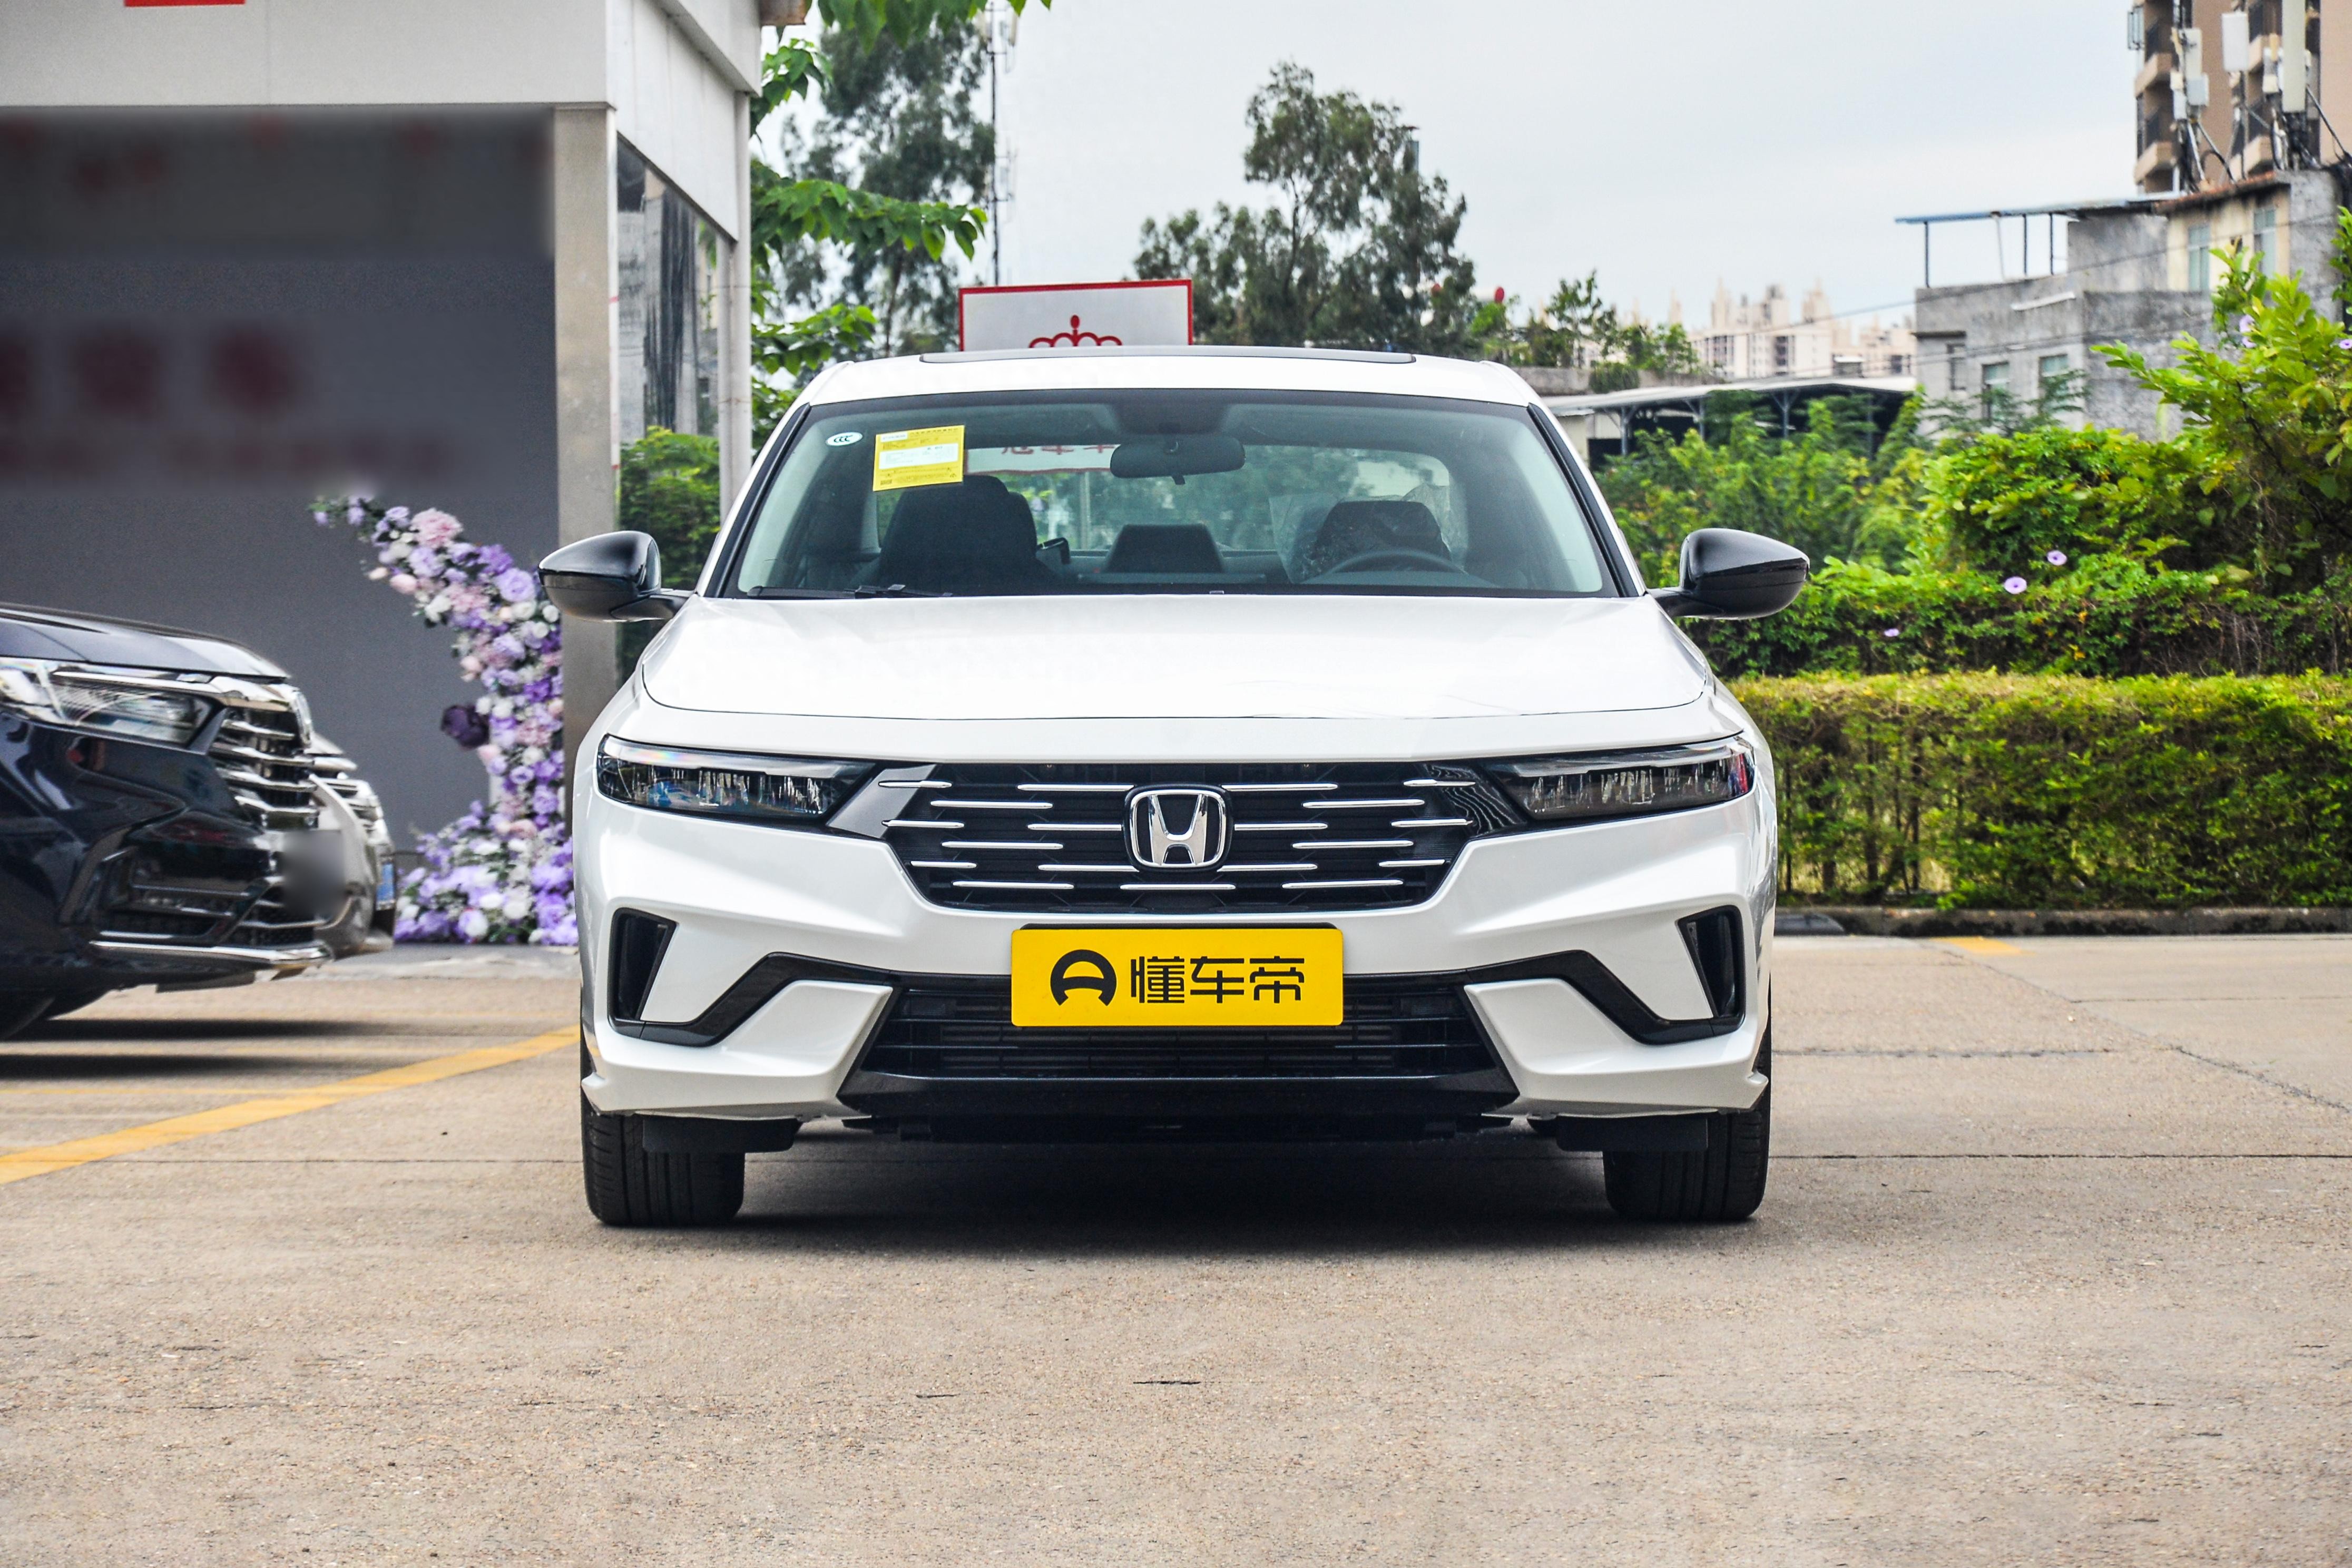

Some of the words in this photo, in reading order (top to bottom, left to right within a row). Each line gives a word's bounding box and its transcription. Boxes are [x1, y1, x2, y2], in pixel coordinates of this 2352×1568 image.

[1148, 793, 1208, 866] H
[1131, 956, 1305, 1004] 懂车帝
